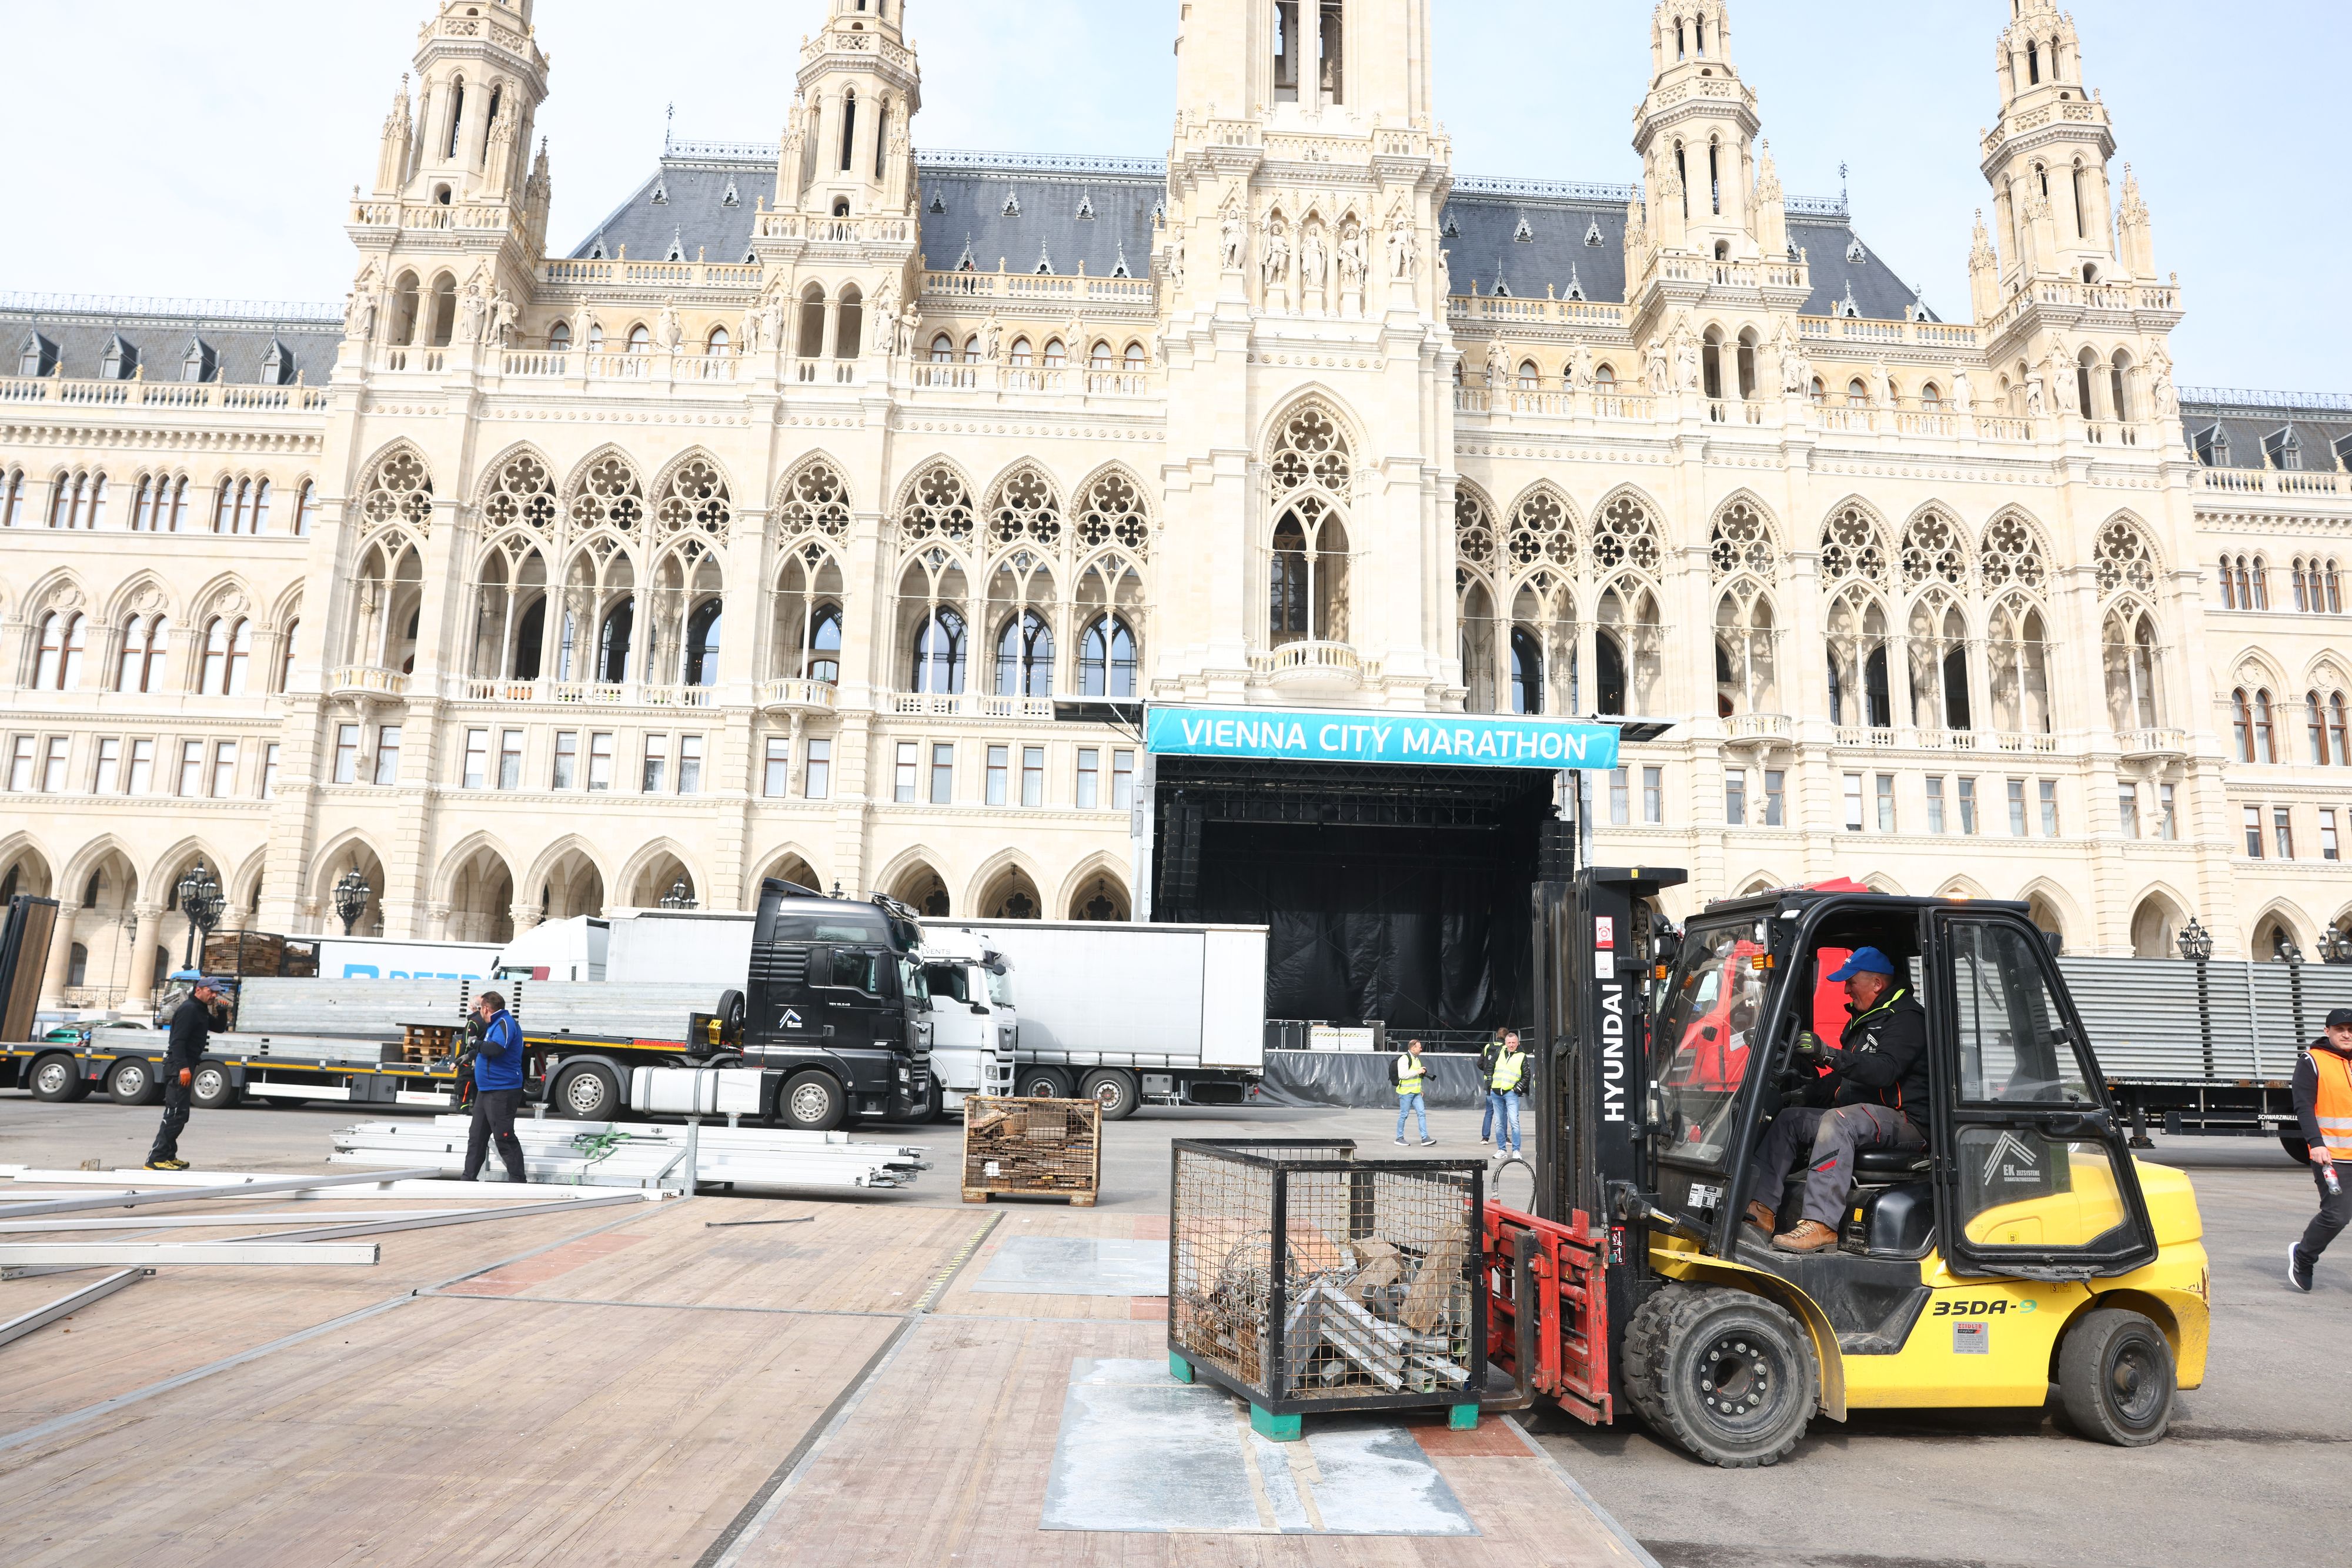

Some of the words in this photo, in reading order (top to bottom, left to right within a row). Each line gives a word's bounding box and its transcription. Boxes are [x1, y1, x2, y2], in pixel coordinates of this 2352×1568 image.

[1181, 718, 1307, 750] VIENNA
[1319, 724, 1391, 753] CITY
[1402, 727, 1587, 760] MARATHON
[1602, 985, 1624, 1121] HYUNDAI
[2003, 1164, 2015, 1176] EK
[1932, 1299, 2038, 1316] 35DA-9
